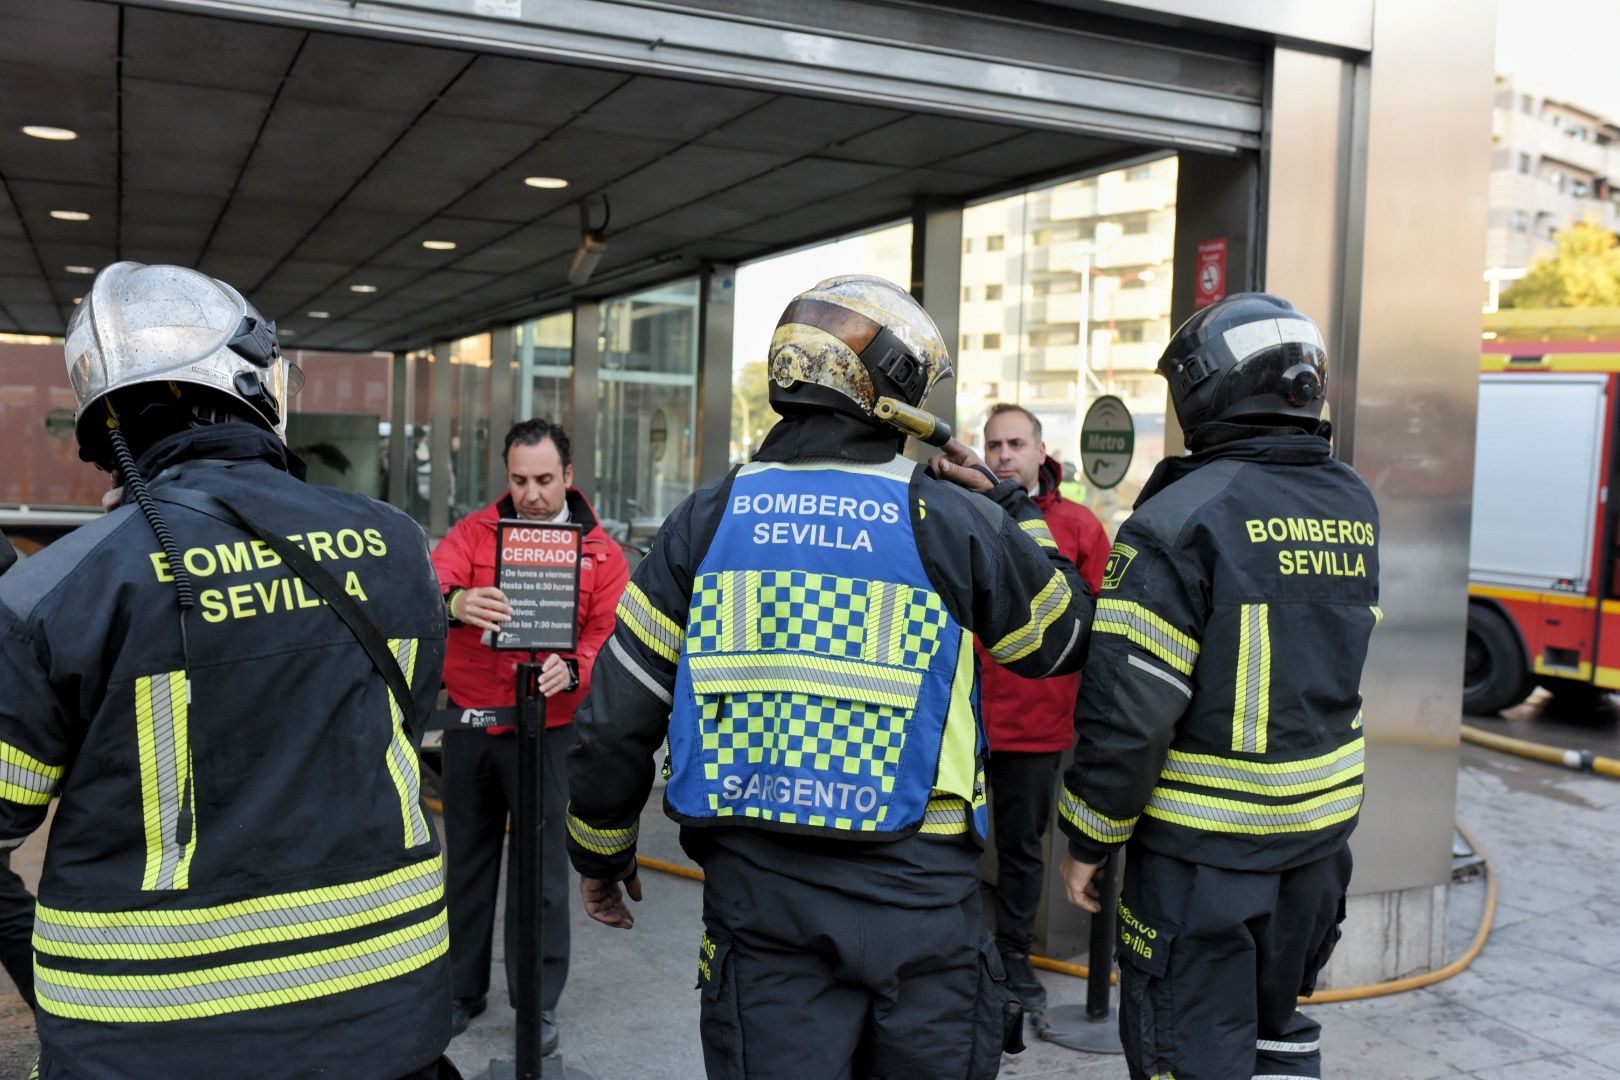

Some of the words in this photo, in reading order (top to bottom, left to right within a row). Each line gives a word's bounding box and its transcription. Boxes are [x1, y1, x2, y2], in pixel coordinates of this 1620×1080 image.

[1087, 433, 1125, 451] Metro
[732, 493, 899, 524] BOMBEROS
[509, 528, 573, 544] ACCESO
[752, 522, 873, 553] SEVILLA
[1246, 517, 1375, 547] BOMBEROS
[502, 547, 578, 564] CERRADO
[1278, 550, 1366, 578] SEVILLA
[505, 569, 516, 577] De
[517, 569, 538, 578] lunes
[500, 581, 523, 590] Hasta
[523, 582, 535, 590] las
[553, 583, 574, 591] horas
[200, 570, 368, 623] SEVILA
[539, 599, 575, 609] domingos
[521, 620, 533, 629] las
[534, 621, 550, 629] 7:30
[551, 621, 572, 629] horas
[722, 773, 877, 813] SARGENTO
